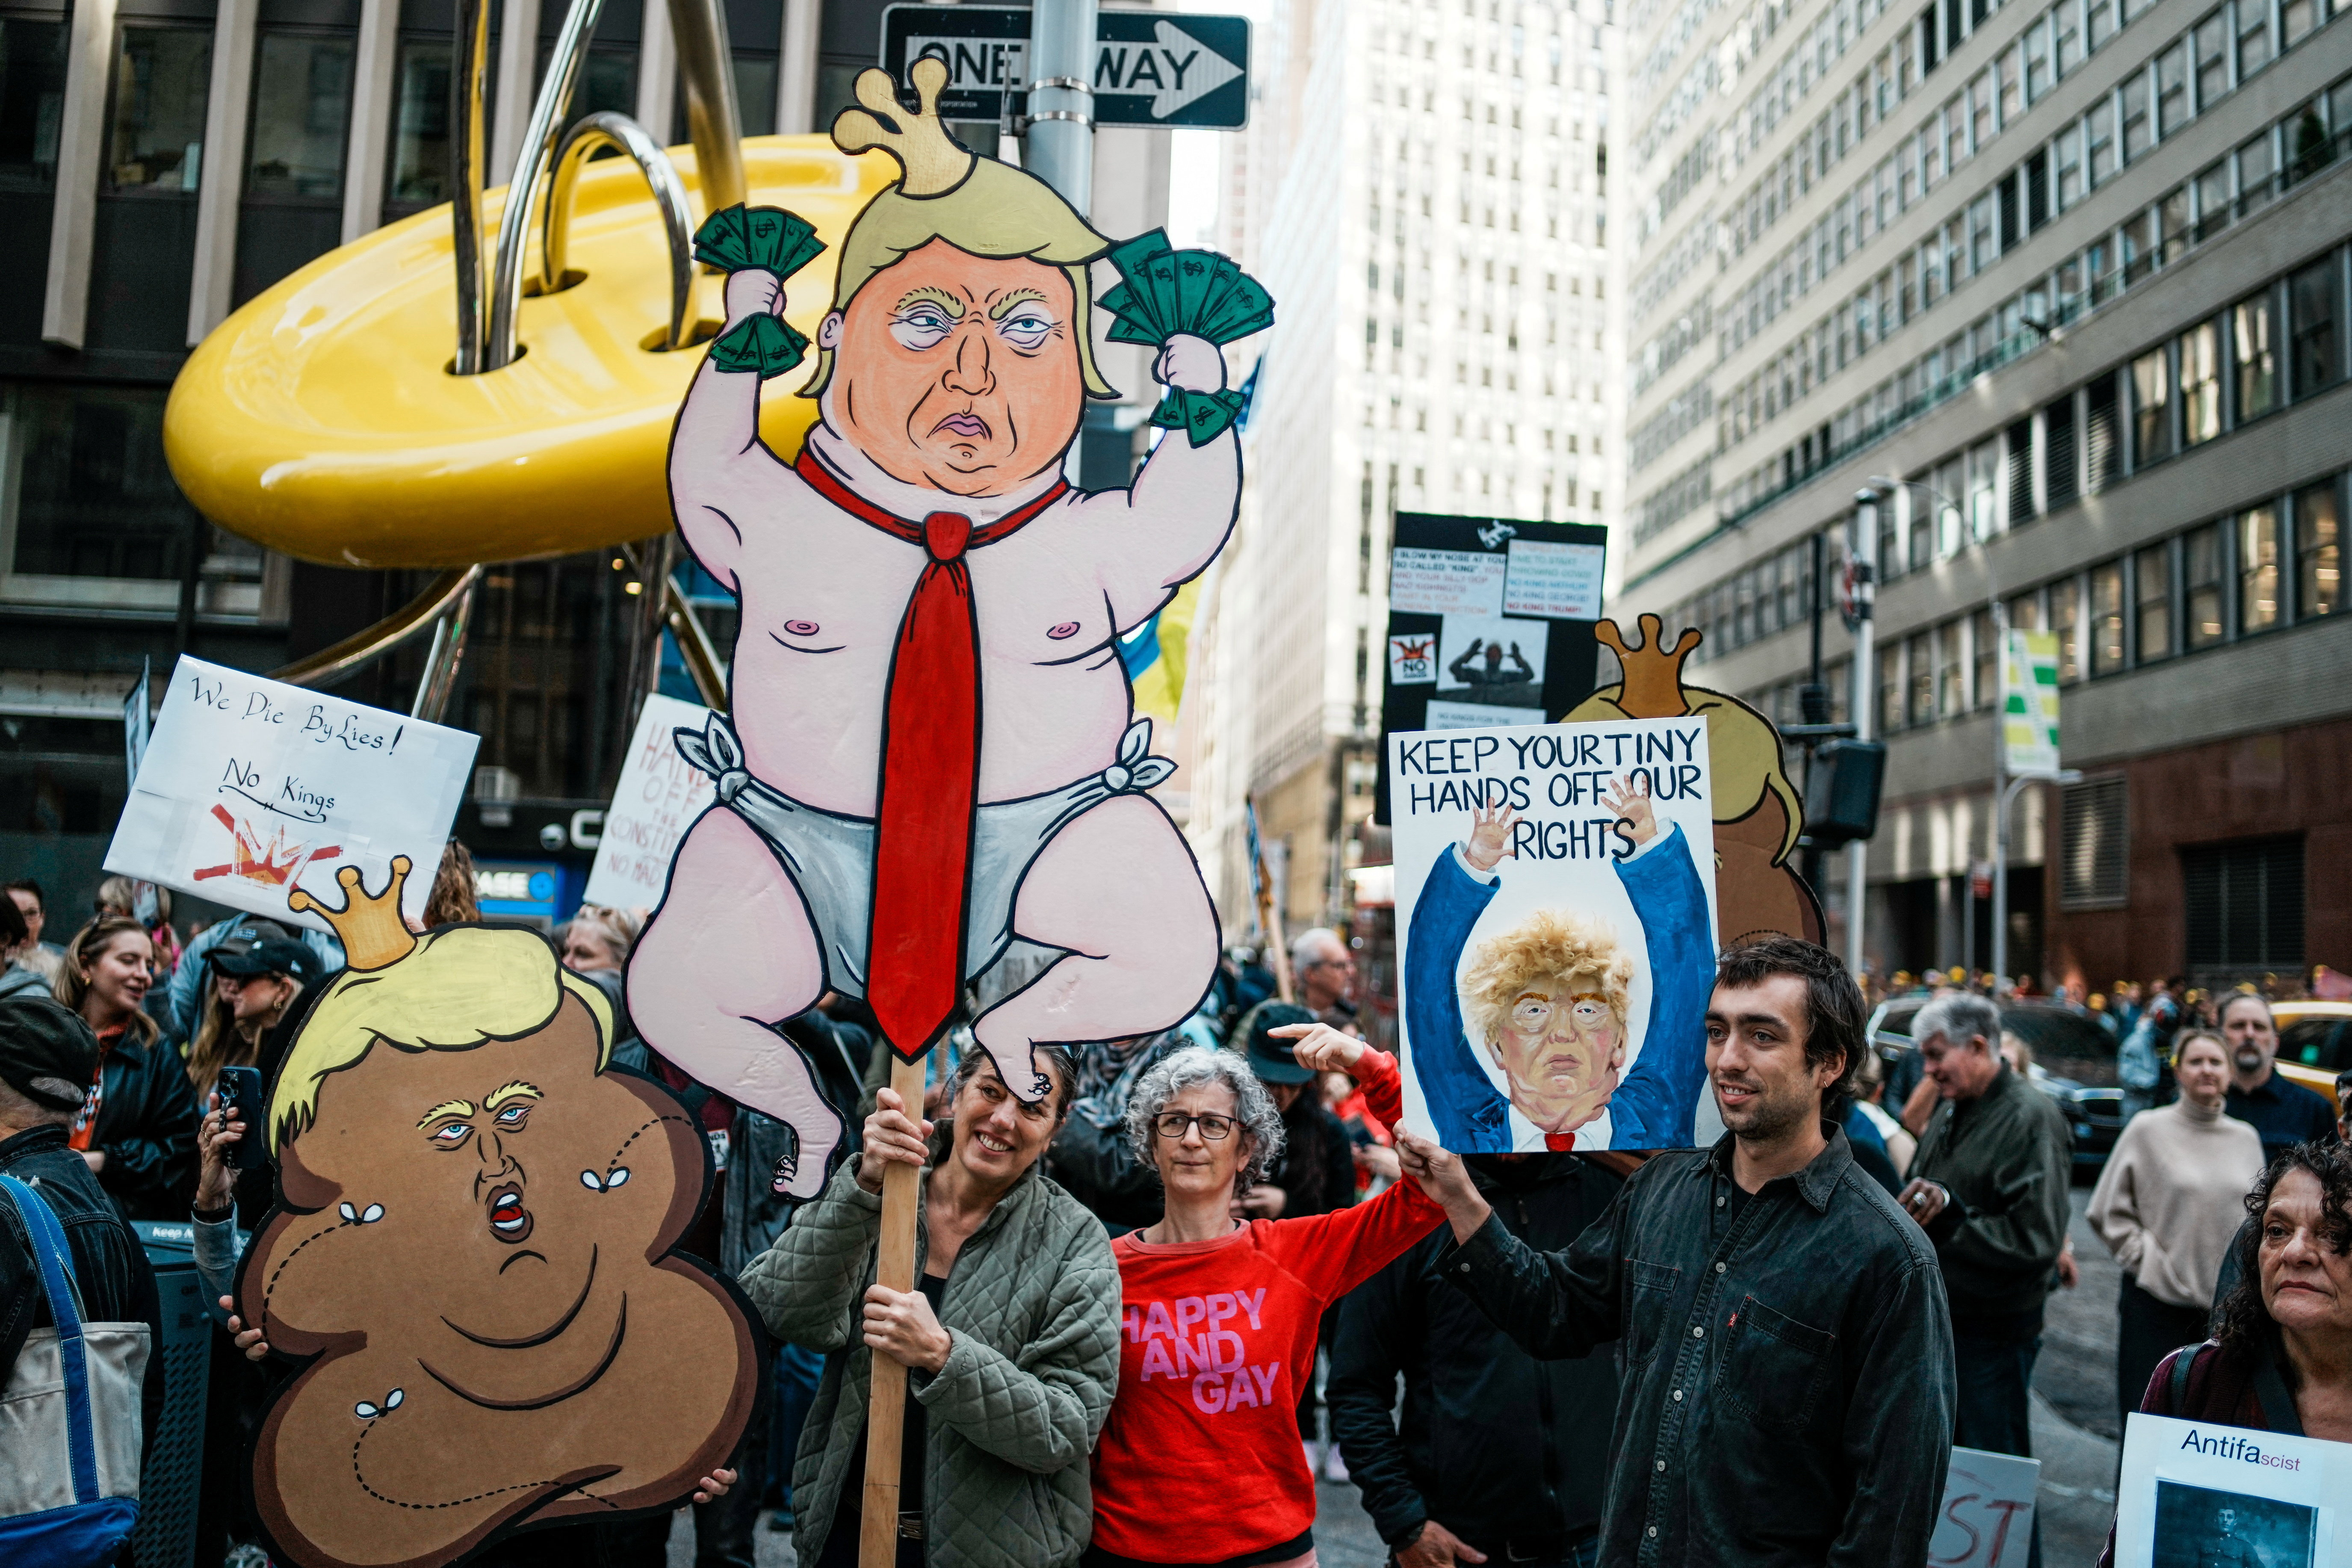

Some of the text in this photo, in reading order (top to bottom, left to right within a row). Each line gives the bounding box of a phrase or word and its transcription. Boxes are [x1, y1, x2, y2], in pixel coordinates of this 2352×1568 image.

[1095, 48, 1199, 90] WAY
[1401, 551, 1426, 559] BLOW
[1445, 553, 1469, 562] NOSE
[1473, 555, 1483, 563] AT
[1487, 556, 1505, 564] YOU
[1410, 562, 1445, 571] CALLED
[1522, 602, 1545, 611] KING
[191, 677, 404, 756] We Die By Lies!
[640, 721, 713, 788] HAND
[1400, 728, 1701, 775] KEEP YOUR TINY
[223, 757, 335, 816] No Kings
[642, 776, 701, 813] OFF
[1411, 765, 1702, 815] HANDS OFF OUR
[610, 814, 682, 855] CONSTIT
[1514, 817, 1636, 860] RIGHTS
[472, 871, 529, 898] ASE
[152, 1226, 183, 1240] Keep
[1123, 1288, 1266, 1343] HAPPY
[1141, 1330, 1244, 1382] AND
[1192, 1361, 1280, 1414] GAY
[2181, 1429, 2301, 1473] Antifascist
